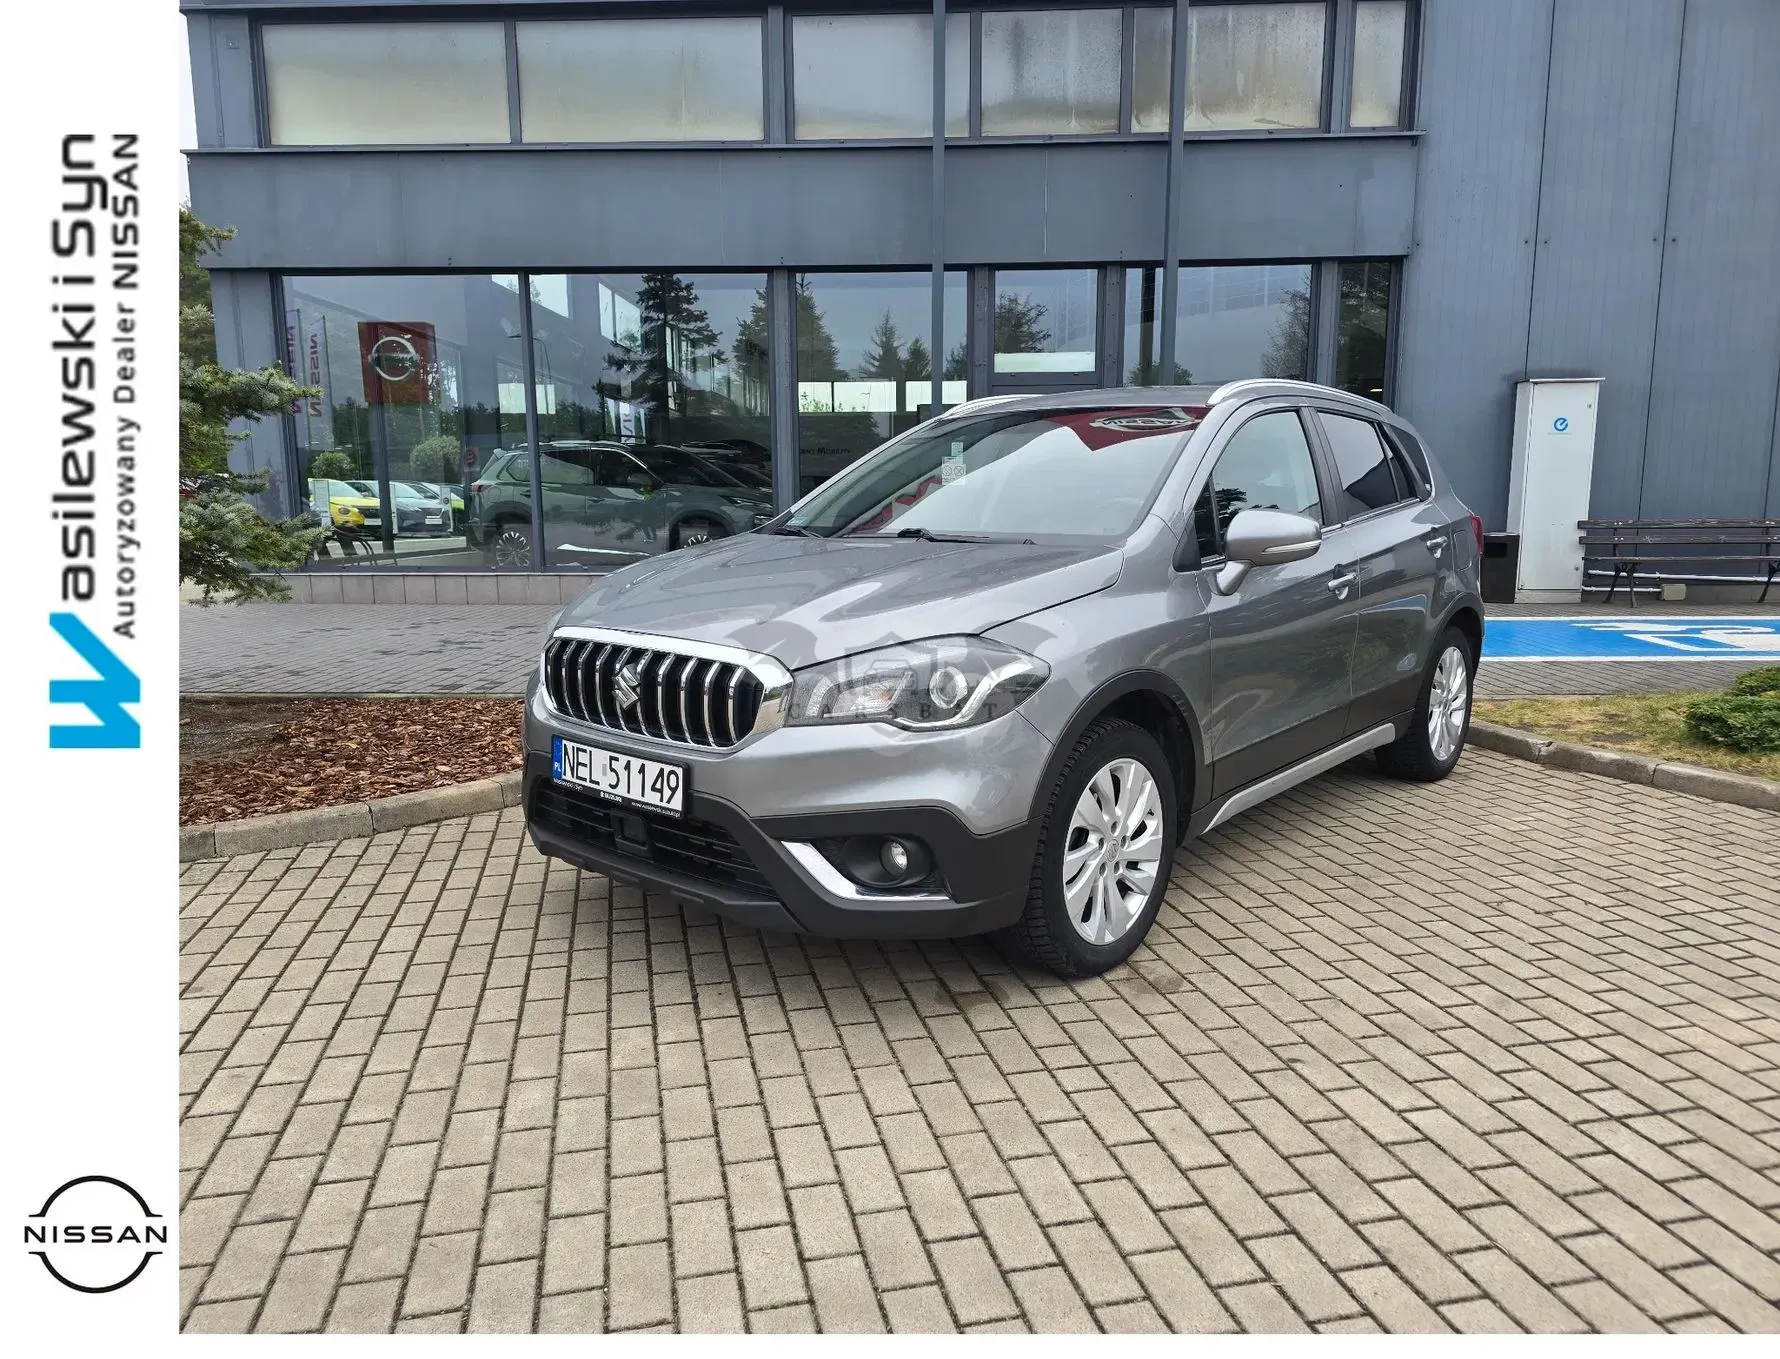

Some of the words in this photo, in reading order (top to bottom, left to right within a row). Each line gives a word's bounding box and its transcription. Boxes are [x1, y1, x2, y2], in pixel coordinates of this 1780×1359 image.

[554, 761, 562, 772] PL
[563, 743, 600, 786] NEL
[608, 755, 680, 805] 51149
